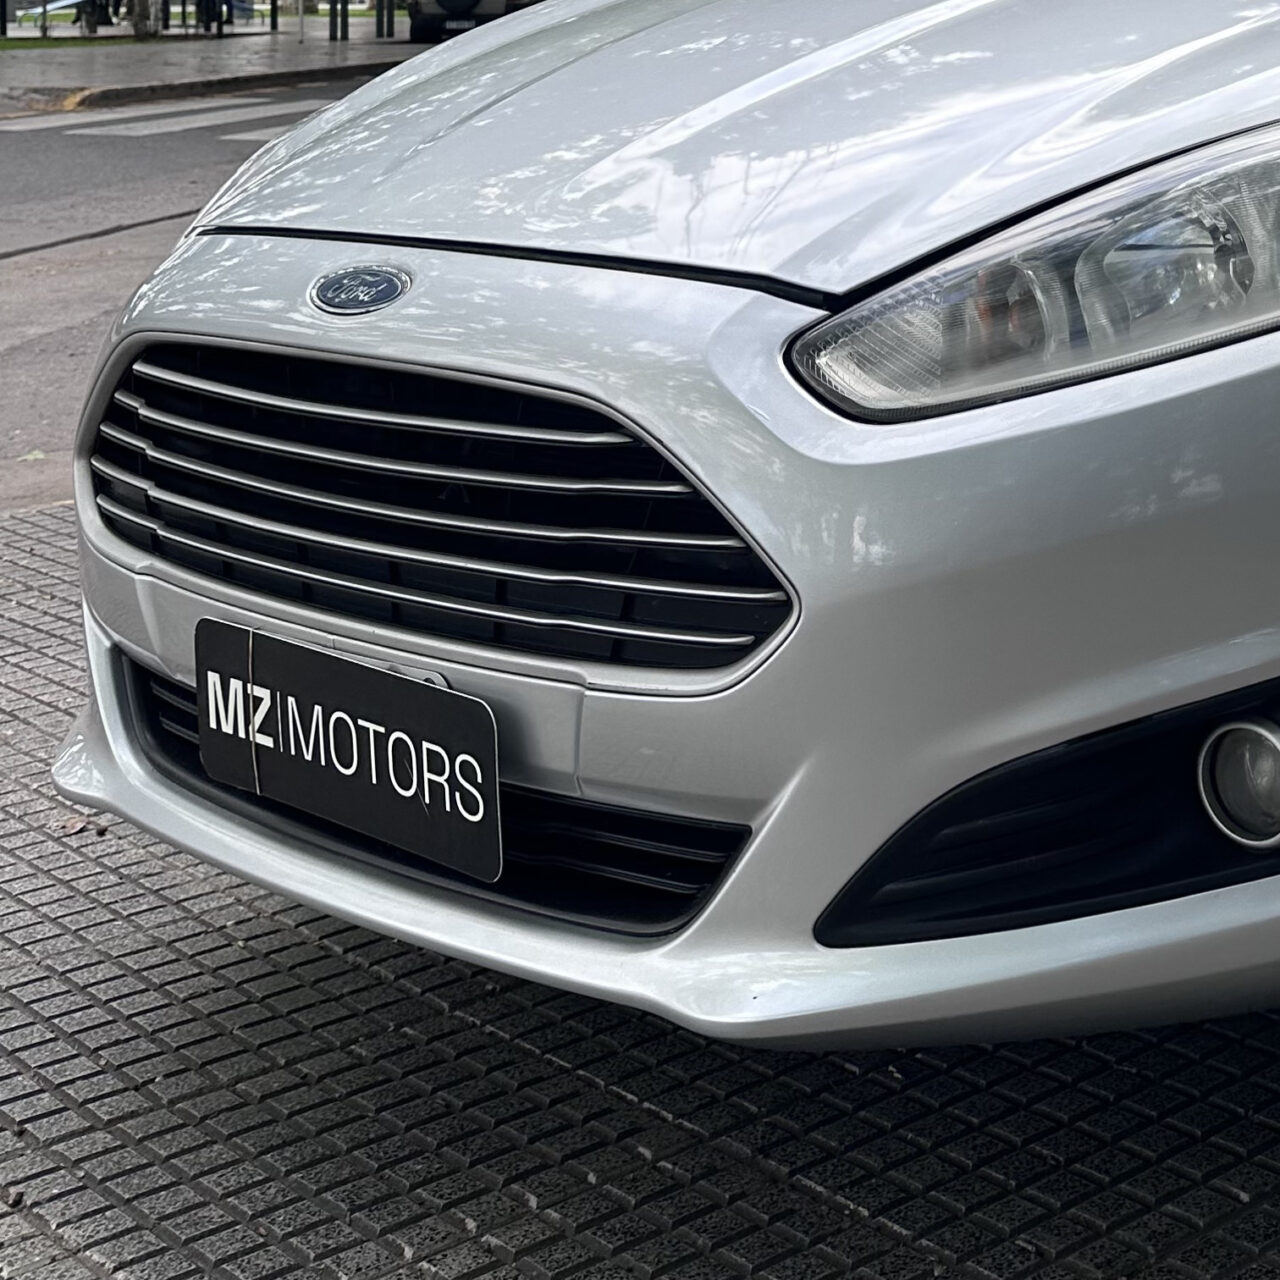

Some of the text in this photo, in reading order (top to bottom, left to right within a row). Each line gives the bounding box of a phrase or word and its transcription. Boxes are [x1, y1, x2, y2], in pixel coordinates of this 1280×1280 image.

[327, 274, 387, 302] Ford
[206, 670, 485, 822] MZ MOTORS
